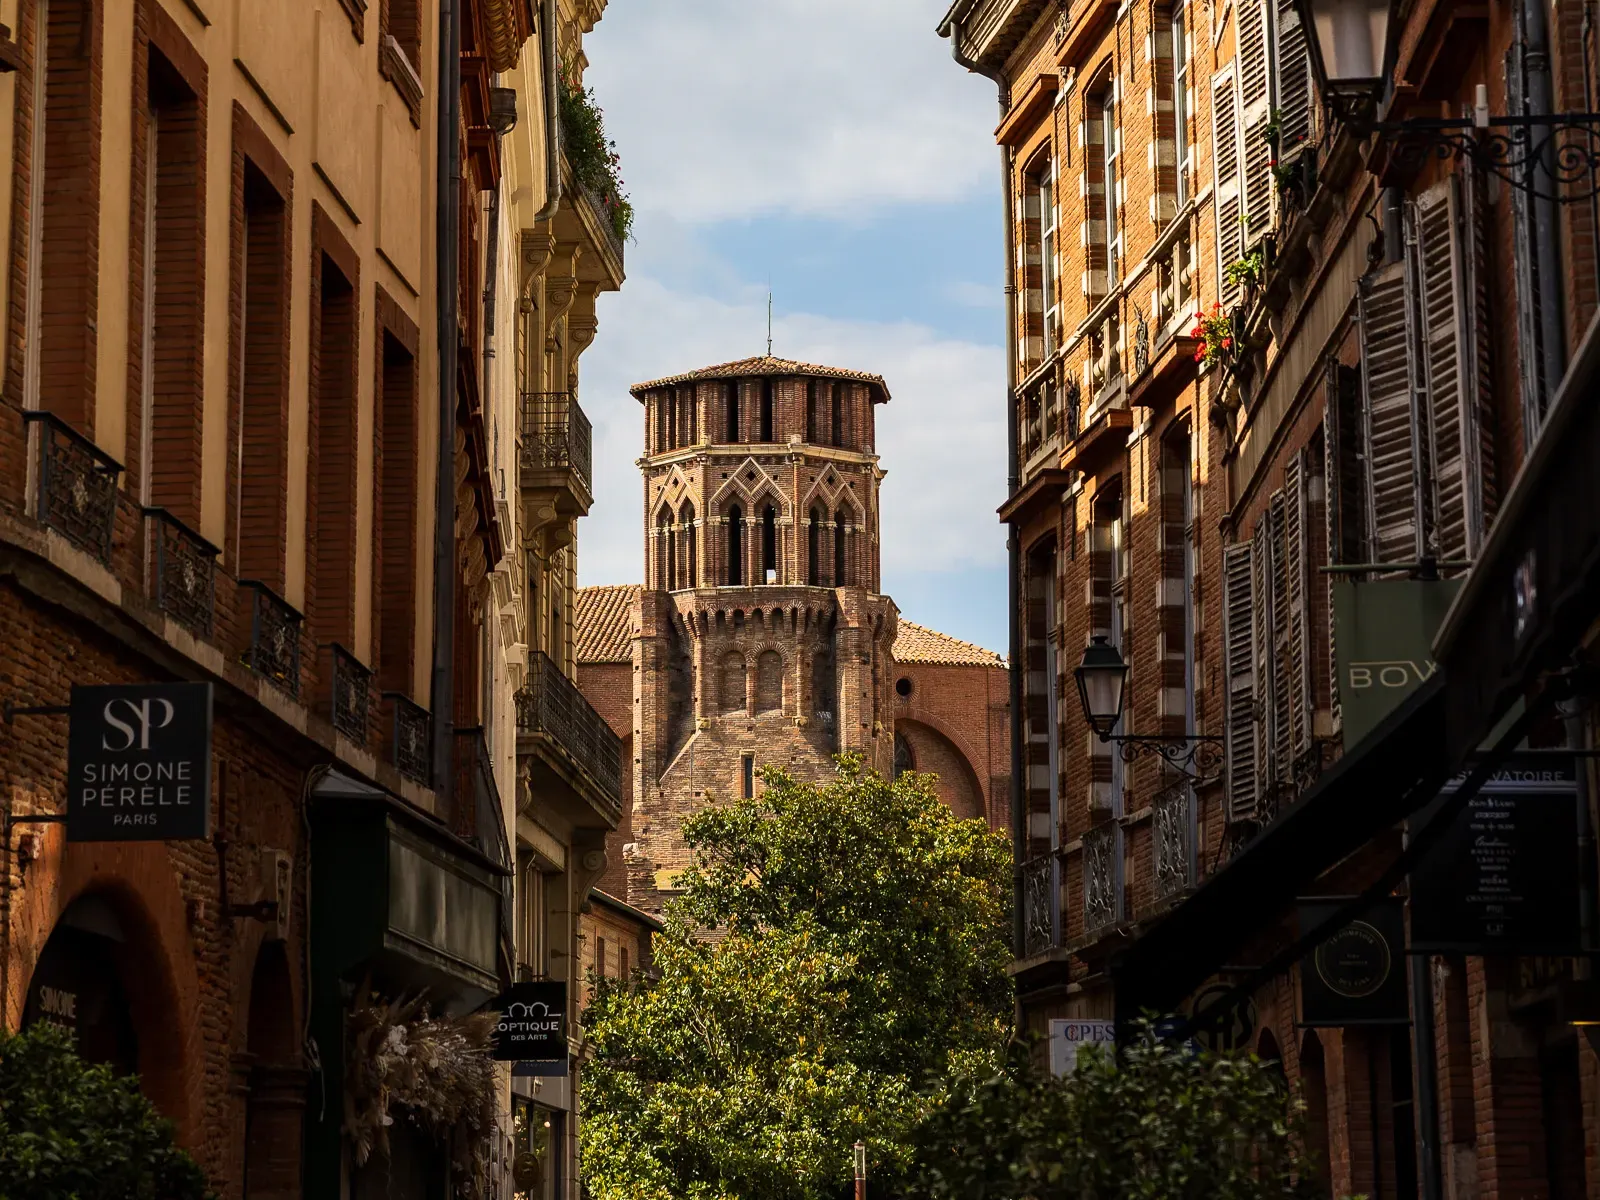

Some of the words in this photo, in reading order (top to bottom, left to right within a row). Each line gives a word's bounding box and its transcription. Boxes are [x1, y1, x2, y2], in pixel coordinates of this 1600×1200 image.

[102, 698, 175, 751] SP
[83, 761, 192, 783] SIMONE
[82, 783, 192, 808] PÉRÈLE
[113, 813, 158, 826] PARIS
[498, 1021, 559, 1033] OPTIQUE
[527, 1033, 548, 1041] ARTS
